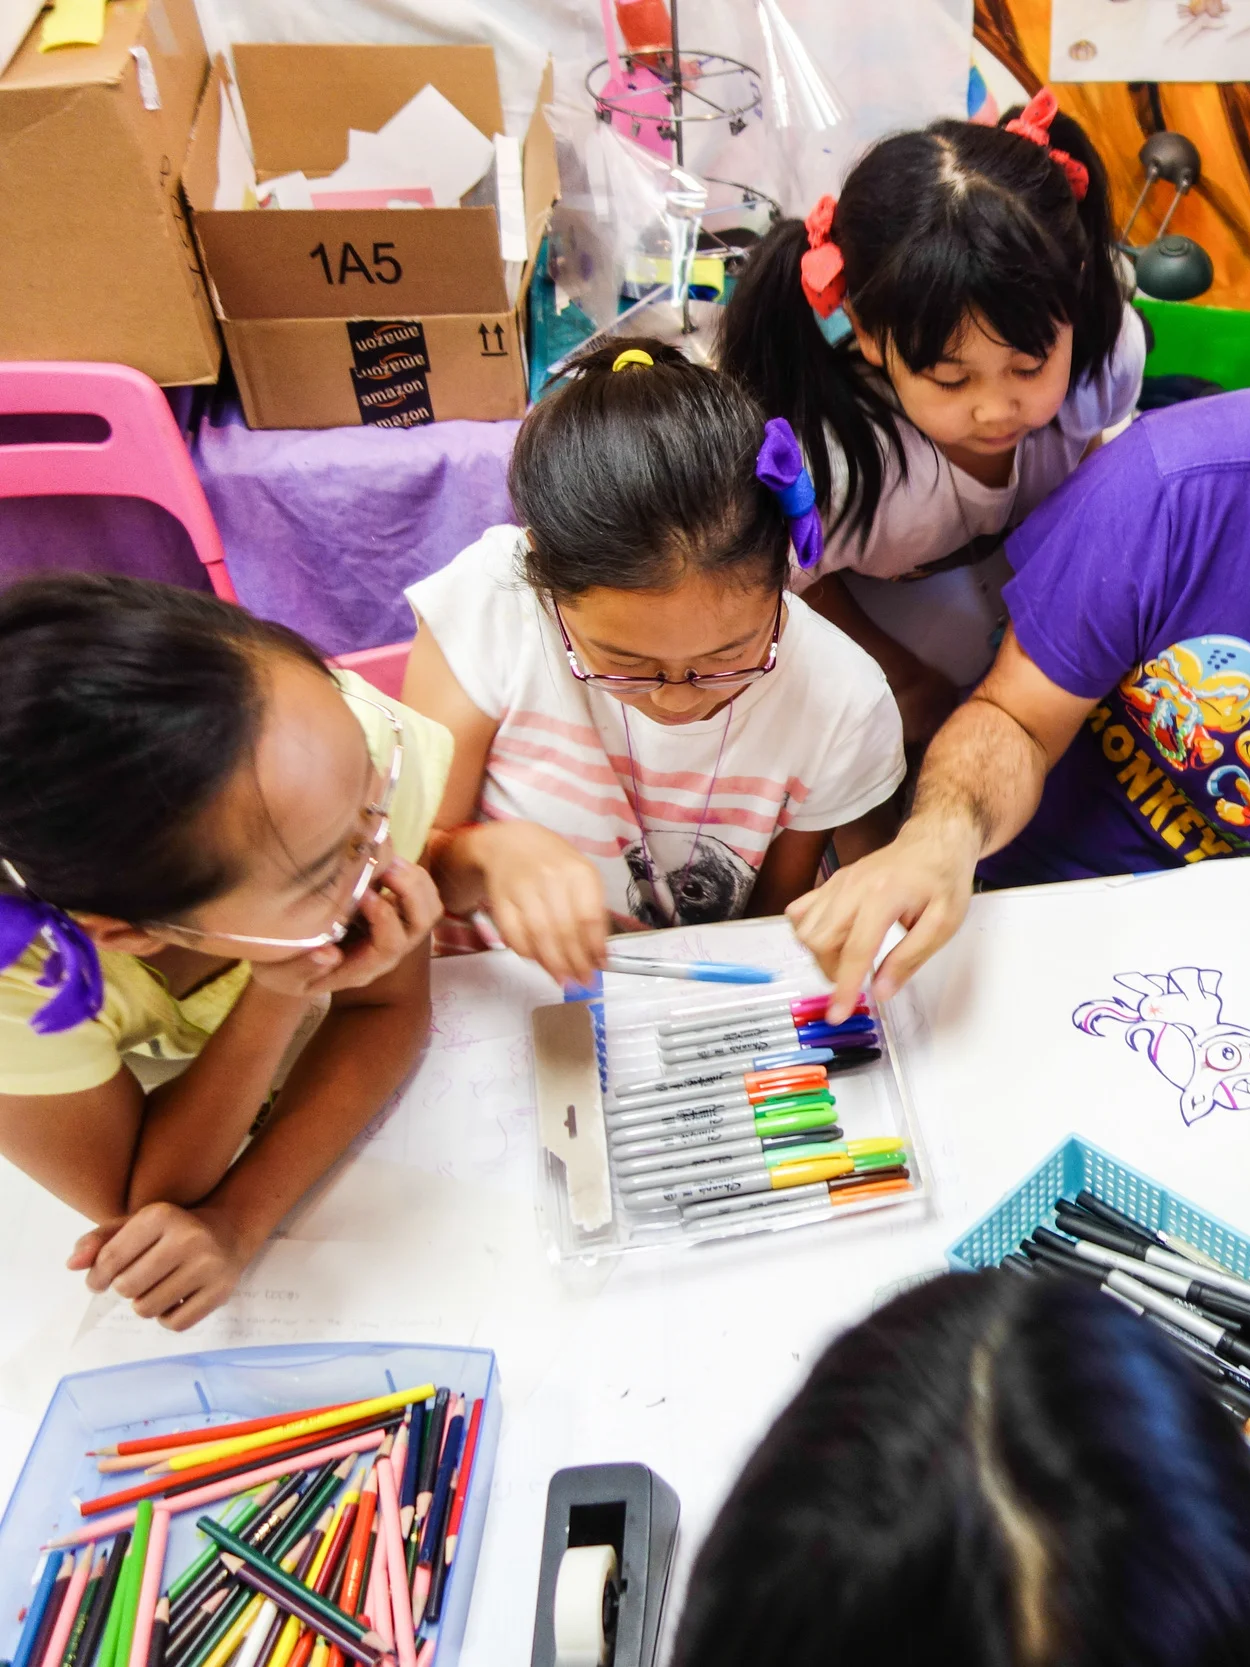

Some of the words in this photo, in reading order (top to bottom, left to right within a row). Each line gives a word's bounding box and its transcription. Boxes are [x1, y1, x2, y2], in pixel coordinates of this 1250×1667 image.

[310, 242, 402, 285] 1A5
[355, 326, 419, 352] amazon
[361, 379, 424, 406] amazon
